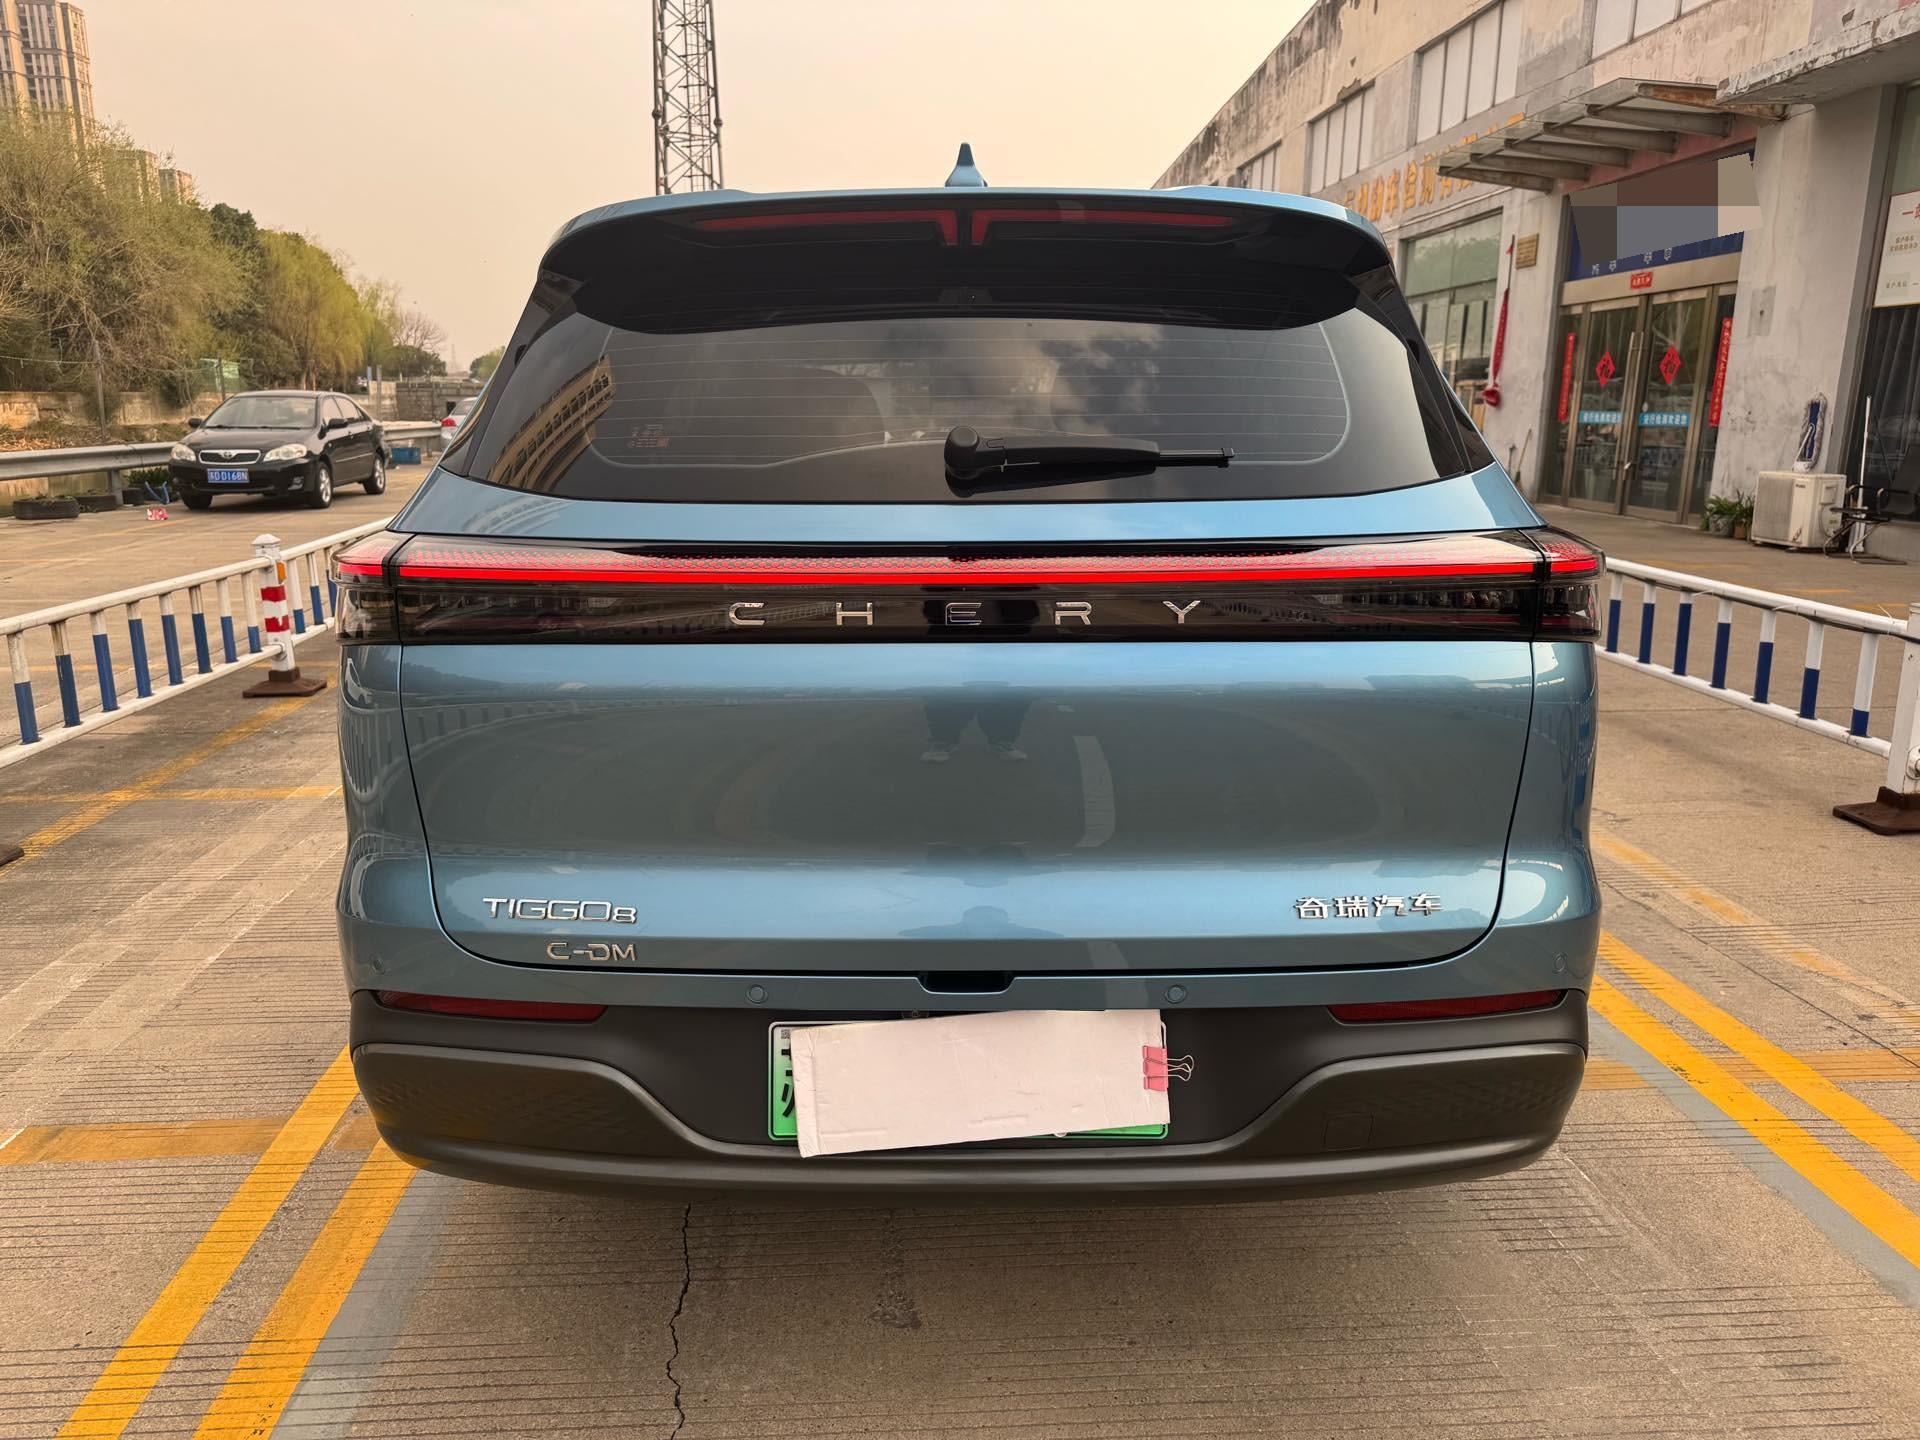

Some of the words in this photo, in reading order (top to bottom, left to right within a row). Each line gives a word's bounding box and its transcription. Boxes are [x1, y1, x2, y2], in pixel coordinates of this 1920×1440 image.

[728, 600, 1202, 626] CHERY
[1294, 893, 1444, 919] 奇瑞汽车
[547, 942, 637, 962] C-DM
